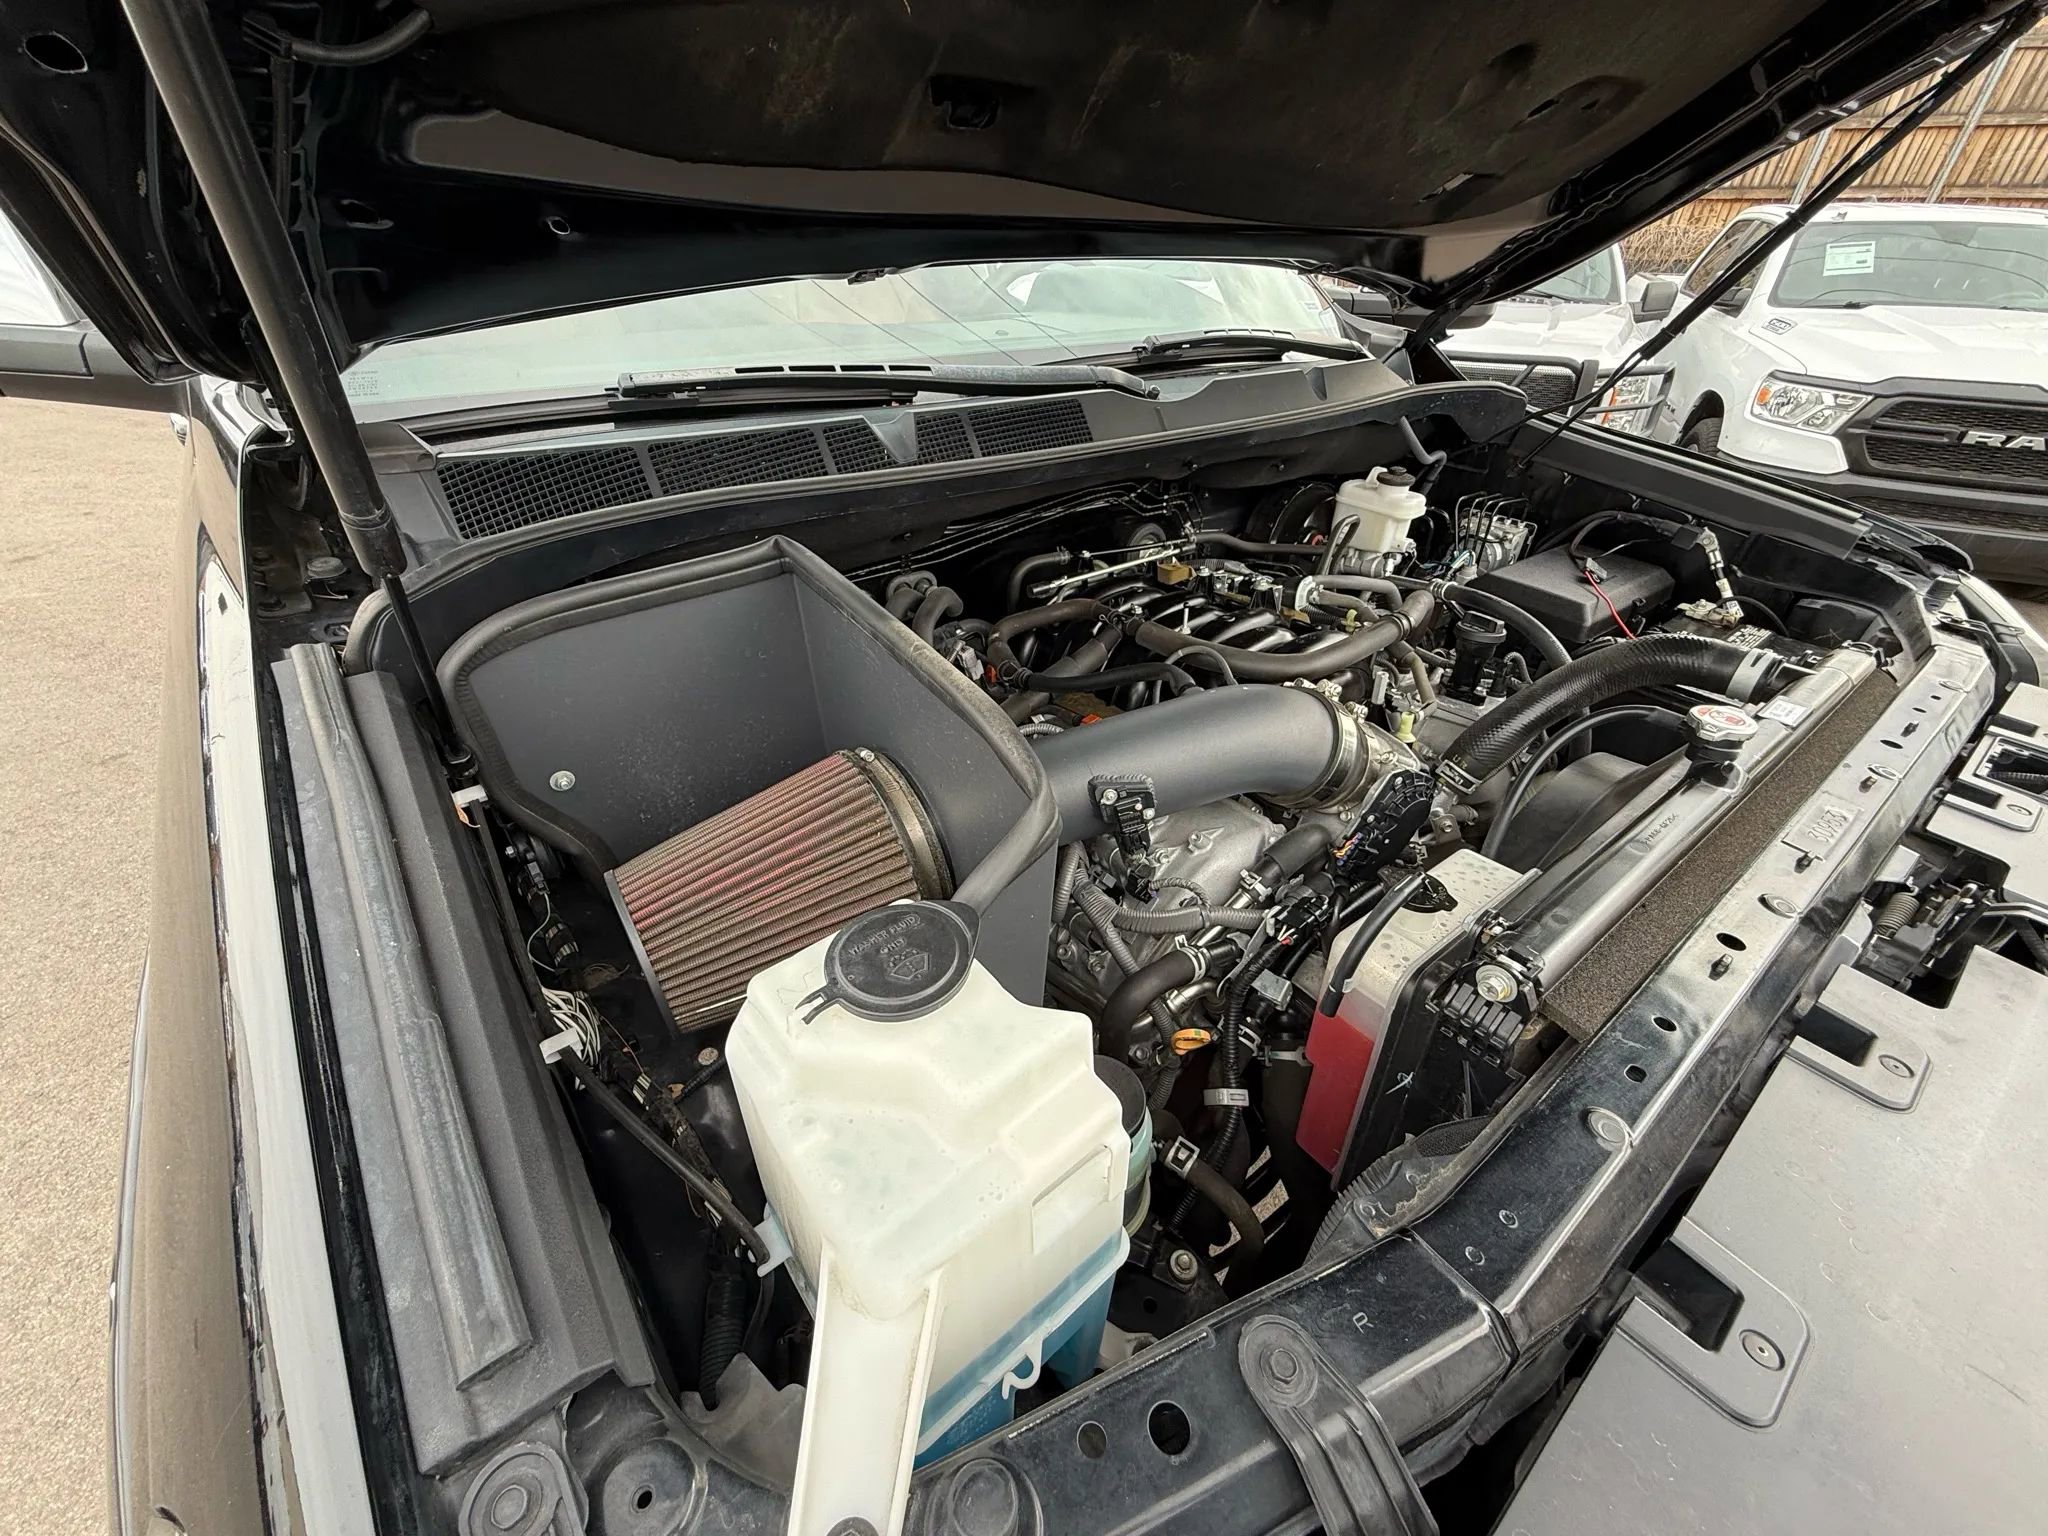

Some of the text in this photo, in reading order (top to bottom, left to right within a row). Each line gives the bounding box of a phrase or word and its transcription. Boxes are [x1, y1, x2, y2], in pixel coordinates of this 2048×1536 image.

[849, 916, 916, 956] WASHER FLUID
[879, 937, 906, 954] ONLY
[1352, 1311, 1375, 1335] R
